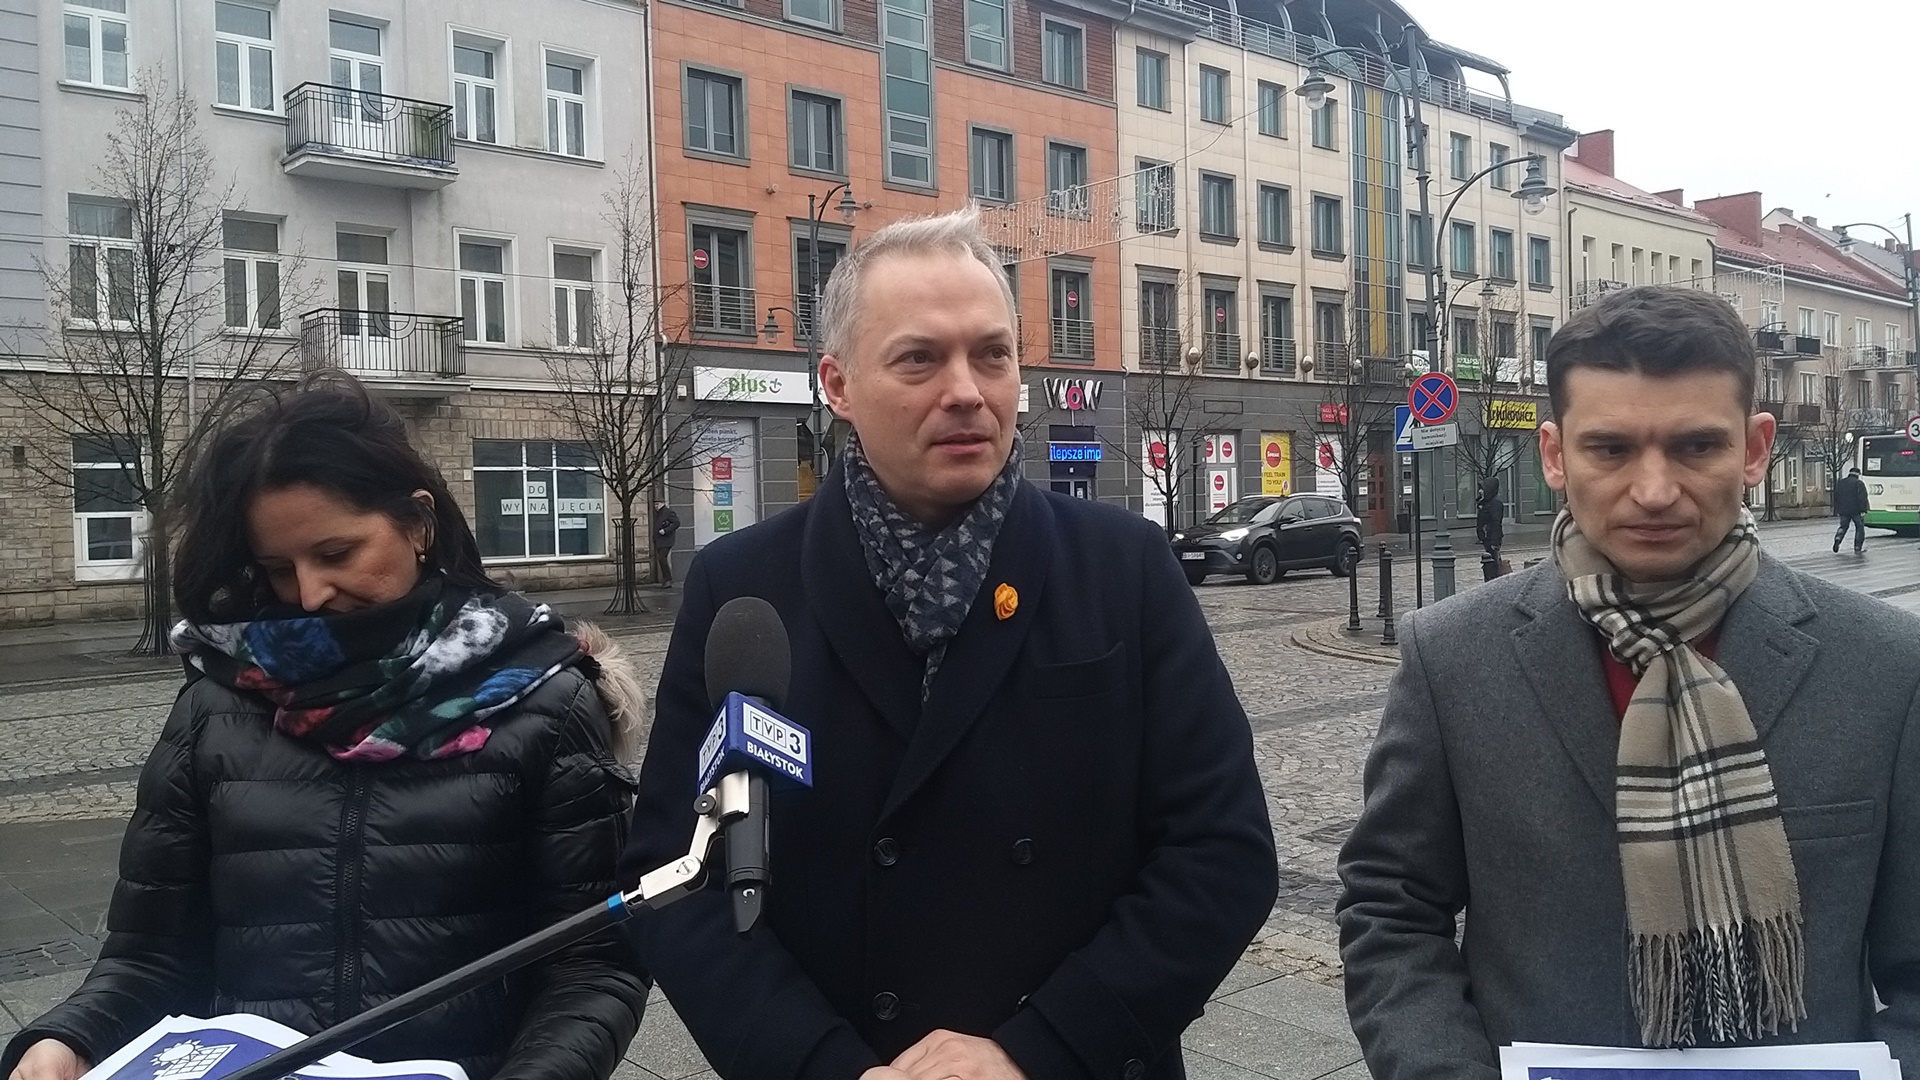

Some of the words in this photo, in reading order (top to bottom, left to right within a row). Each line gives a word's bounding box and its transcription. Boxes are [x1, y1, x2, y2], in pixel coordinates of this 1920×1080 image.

[729, 373, 767, 396] plus
[1043, 377, 1103, 411] WOW
[528, 485, 546, 494] DO
[752, 716, 784, 742] TVP
[789, 732, 802, 755] 3
[747, 740, 804, 780] BIAŁYSTOK
